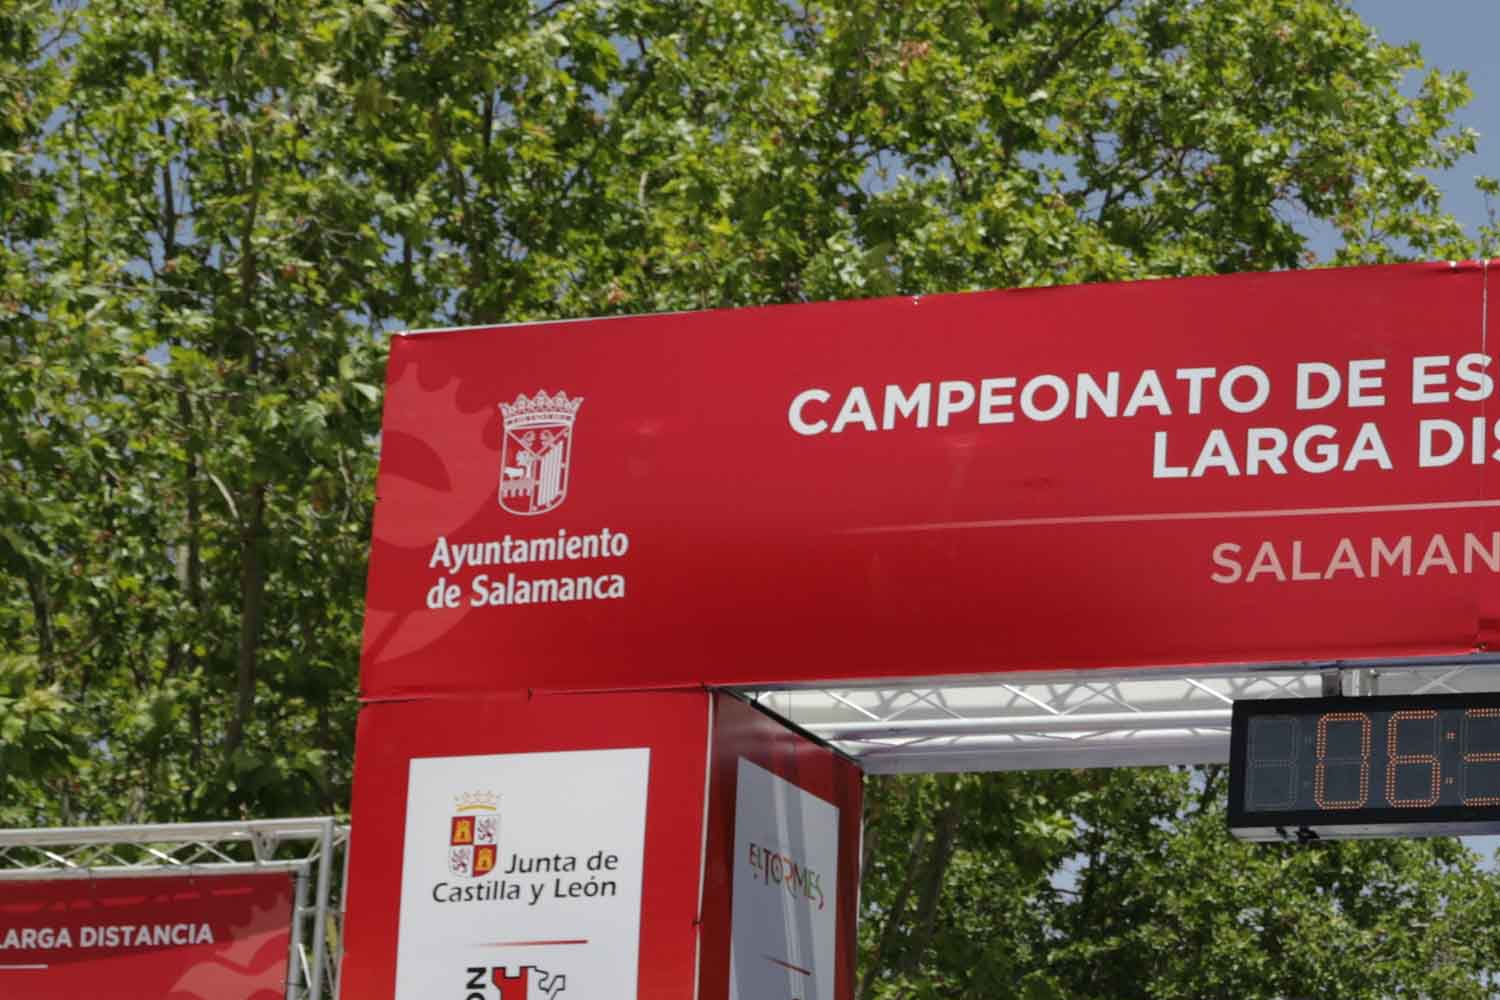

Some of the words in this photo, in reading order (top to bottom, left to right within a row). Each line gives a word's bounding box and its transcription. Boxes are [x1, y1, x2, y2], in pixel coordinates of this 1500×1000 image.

[788, 364, 1270, 436] CAMPEONATO
[1296, 358, 1387, 410] DE
[1153, 422, 1393, 479] LARGA
[429, 526, 629, 570] Ayuntamiento
[426, 577, 461, 609] de
[470, 572, 626, 608] Salamanca
[504, 852, 577, 876] Junta
[586, 849, 619, 873] de
[431, 879, 521, 904] Castilla
[528, 885, 546, 906] y
[553, 876, 618, 900] León
[0, 927, 72, 949] ARGA
[79, 923, 215, 949] DISTANCIA
